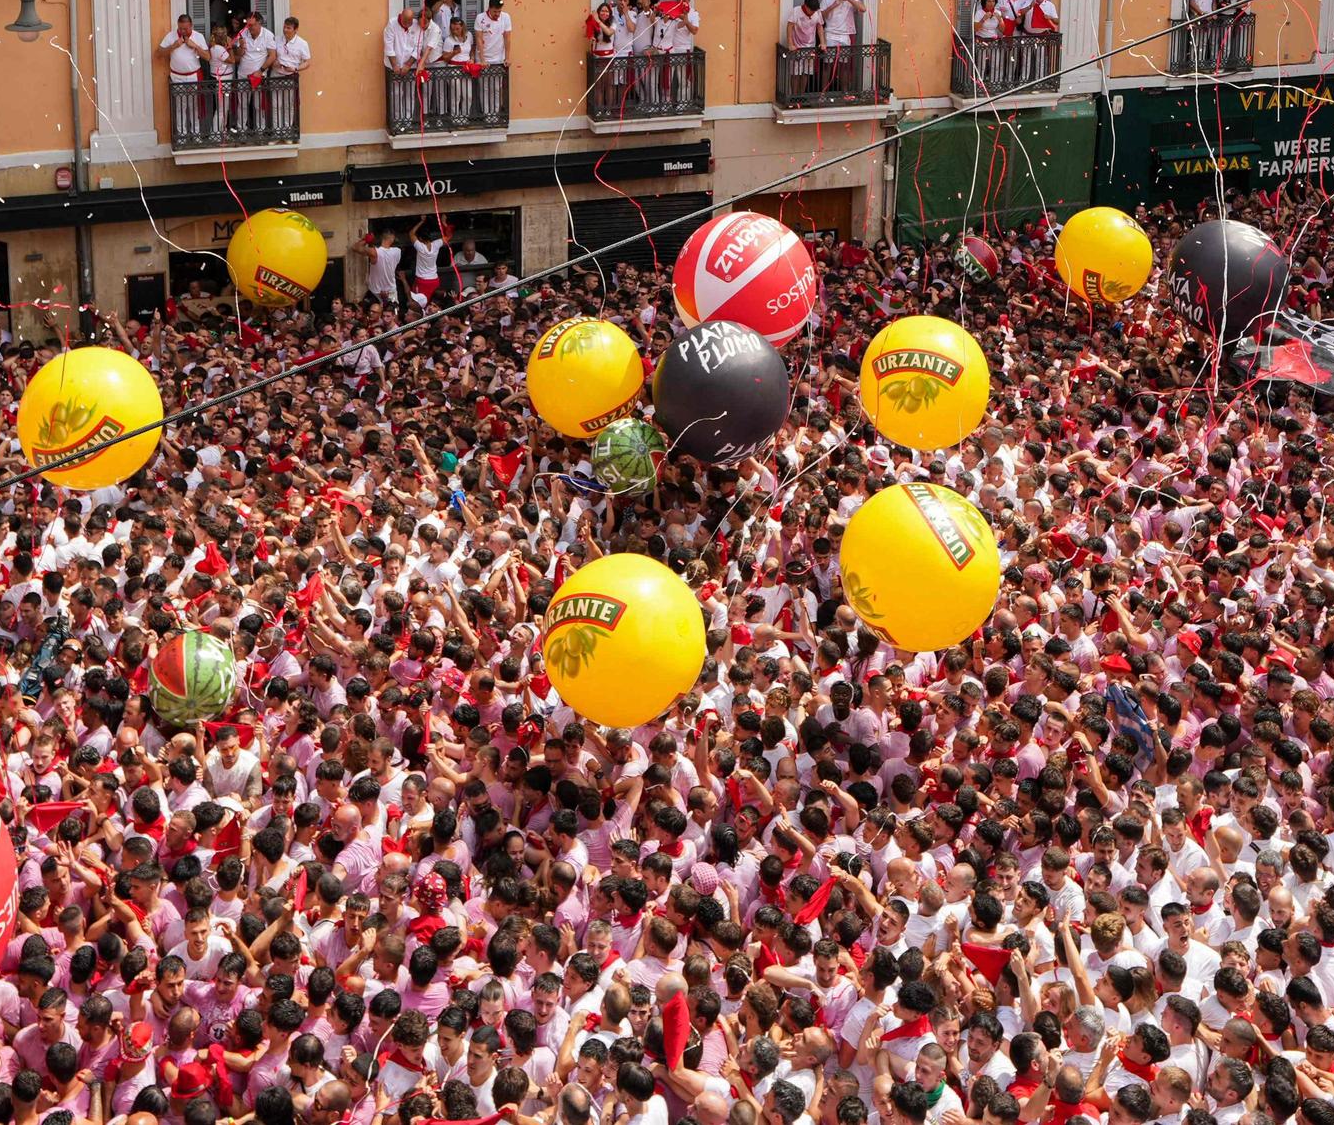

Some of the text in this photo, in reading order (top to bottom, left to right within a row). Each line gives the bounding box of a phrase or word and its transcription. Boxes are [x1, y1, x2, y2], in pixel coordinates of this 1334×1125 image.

[664, 161, 693, 171] Mahou
[1173, 155, 1252, 175] VIANDAS
[289, 191, 324, 202] Mahou
[369, 179, 458, 200] BAR MOL
[1085, 275, 1101, 304] ANTE
[678, 321, 741, 363] PLATA
[698, 332, 762, 375] PLOMO
[877, 352, 957, 379] URZANTE
[587, 392, 643, 431] URZANT
